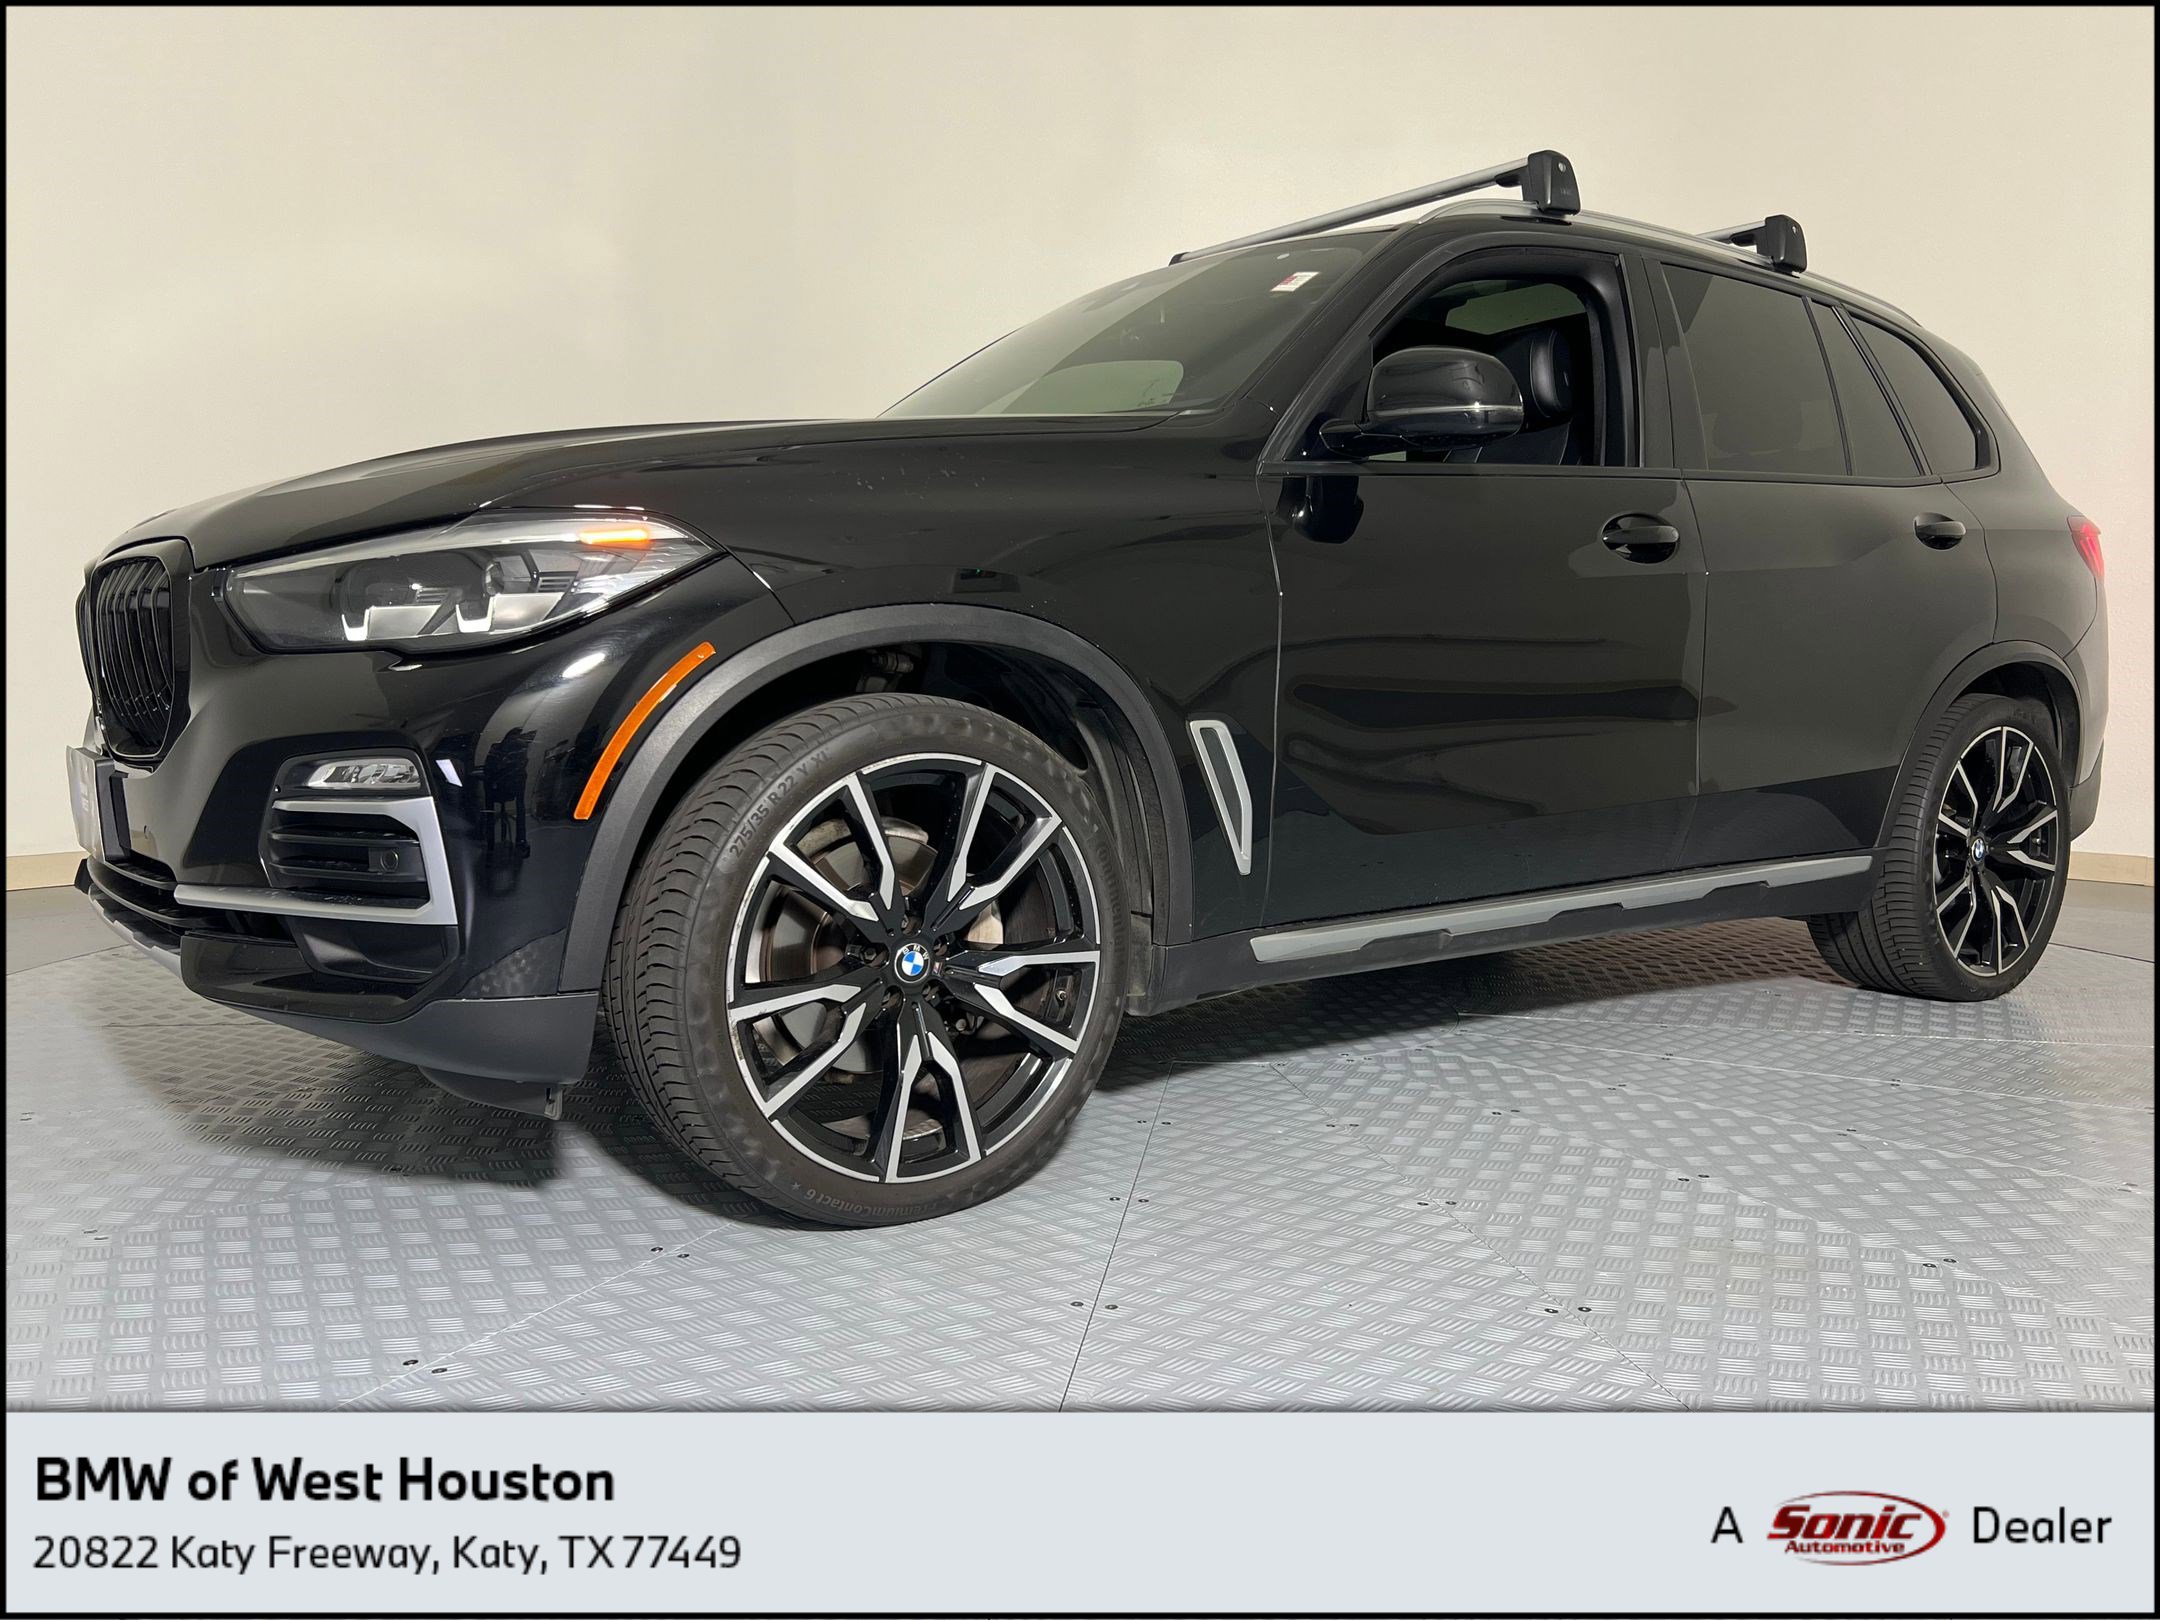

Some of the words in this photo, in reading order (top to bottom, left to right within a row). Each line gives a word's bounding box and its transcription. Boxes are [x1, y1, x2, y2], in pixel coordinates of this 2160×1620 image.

[729, 804, 770, 859] 275/35
[767, 792, 782, 806] R
[778, 775, 798, 795] 22
[796, 762, 809, 777] Y
[902, 944, 929, 960] BMW
[804, 1188, 817, 1200] 6
